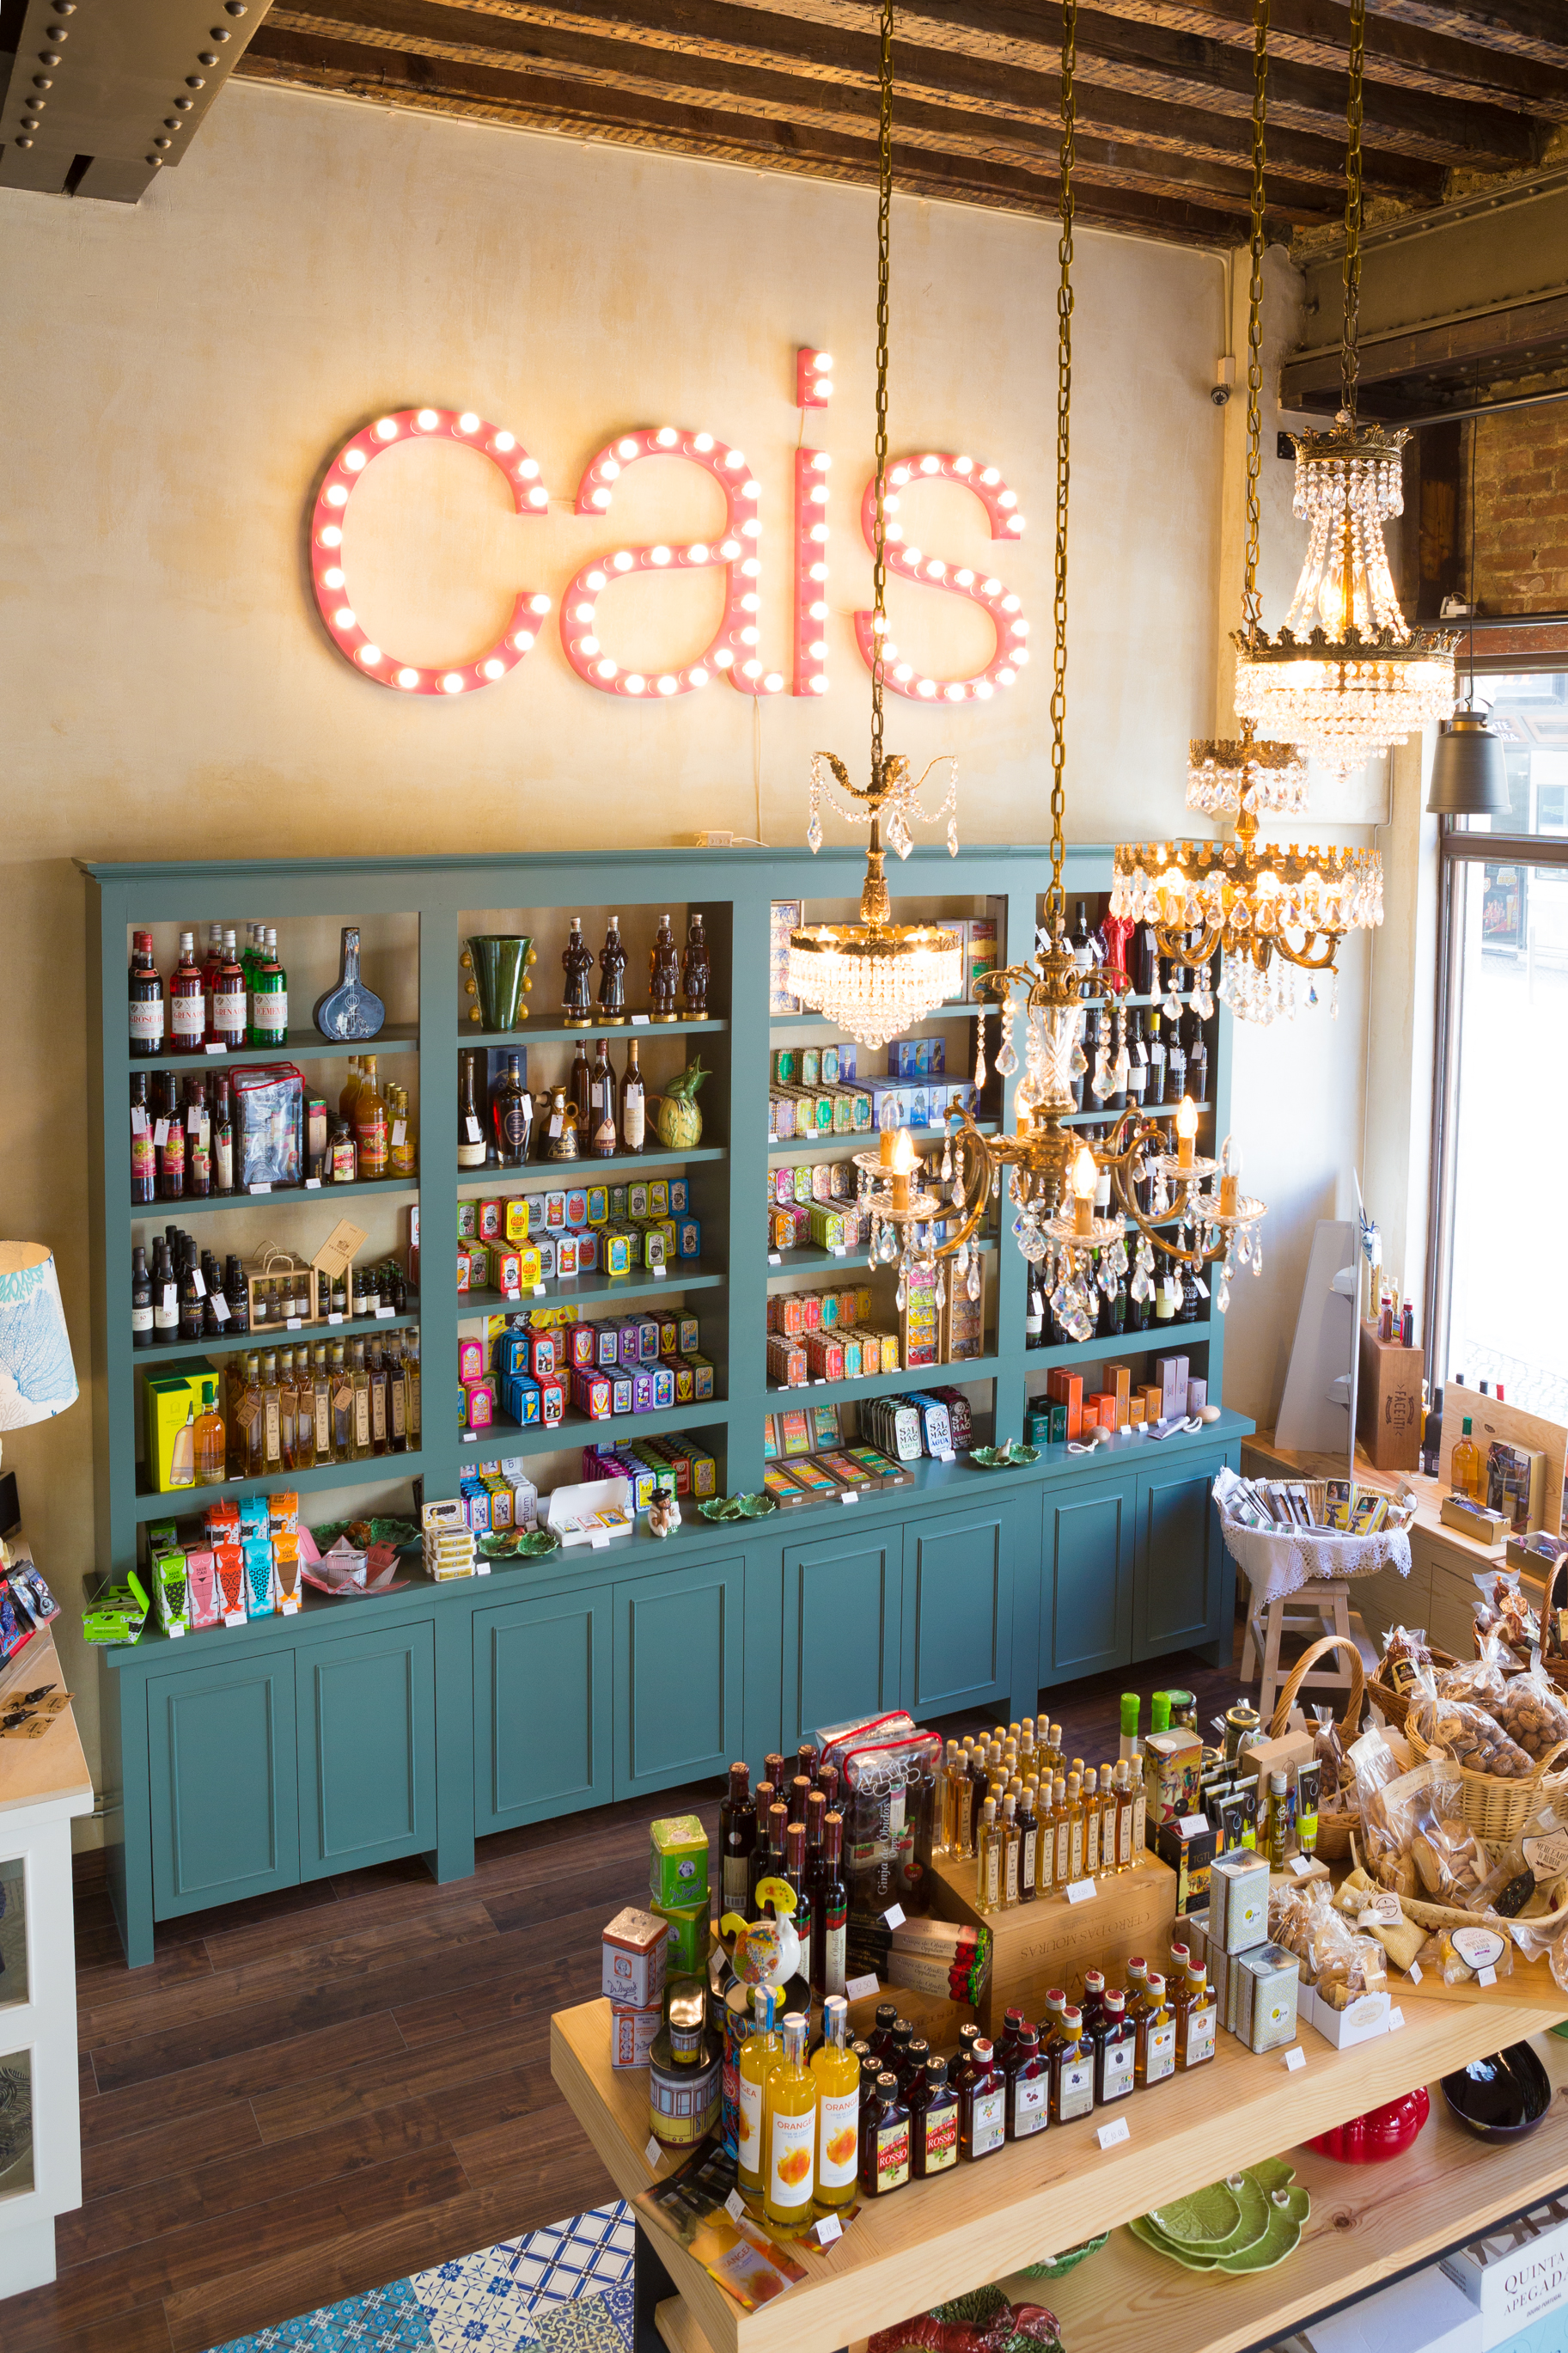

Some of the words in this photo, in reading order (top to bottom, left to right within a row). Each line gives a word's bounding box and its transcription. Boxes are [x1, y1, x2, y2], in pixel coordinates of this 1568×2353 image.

[311, 347, 1026, 703] cais
[882, 1843, 888, 1860] de
[877, 1862, 891, 1895] Ginja
[928, 2131, 955, 2148] ROSSIO
[879, 2148, 907, 2167] ROSSIO
[1504, 2252, 1565, 2295] QUINTA
